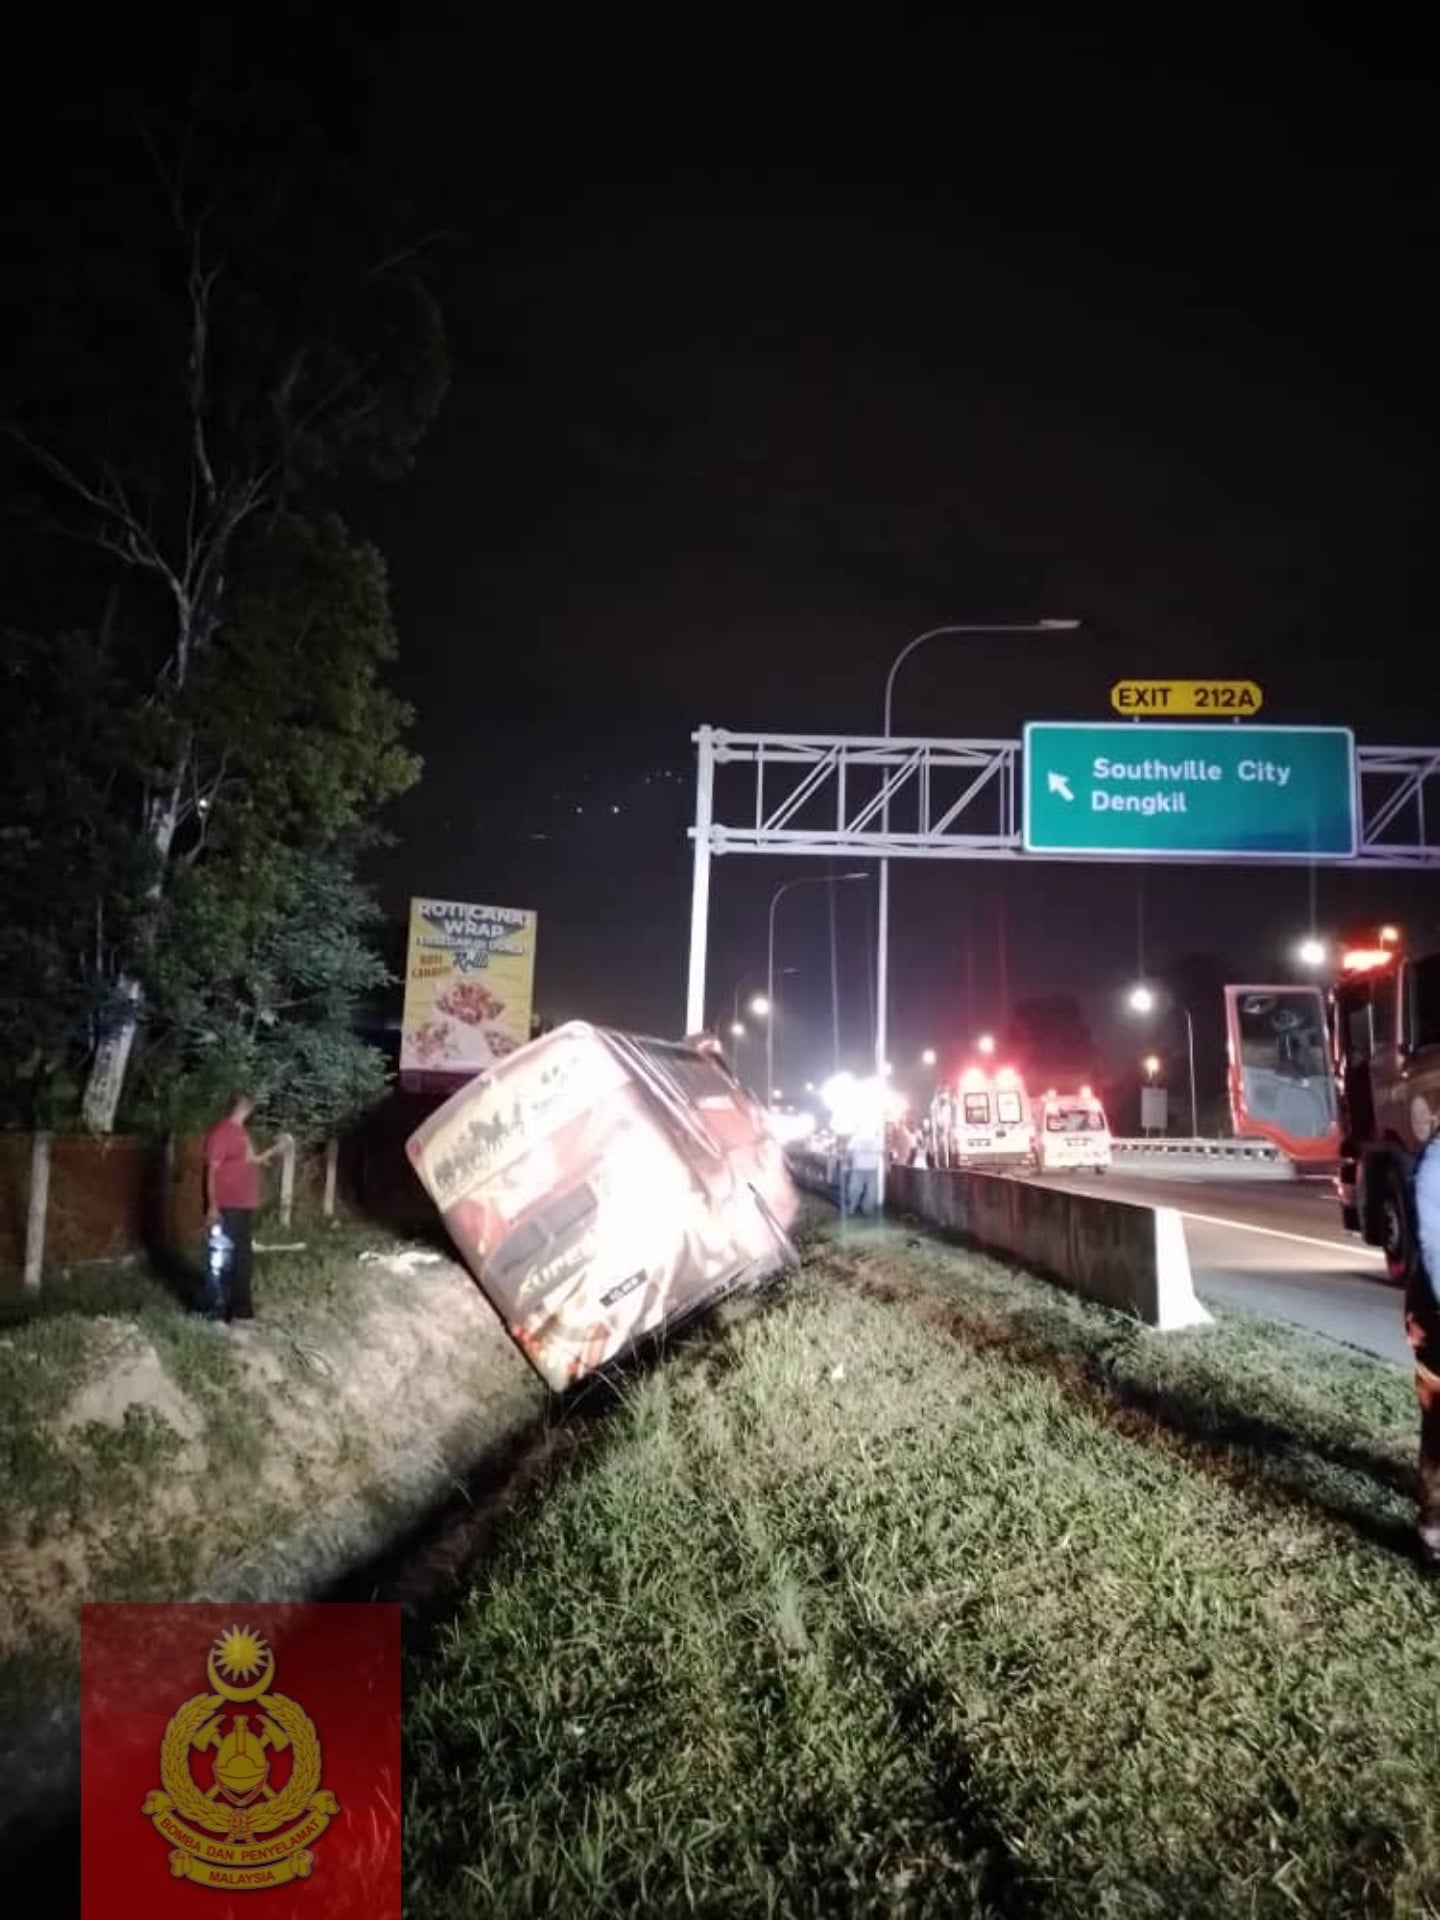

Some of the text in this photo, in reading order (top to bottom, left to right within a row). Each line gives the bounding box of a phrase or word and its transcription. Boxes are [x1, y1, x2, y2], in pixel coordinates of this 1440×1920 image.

[1118, 688, 1255, 708] EXIT 212A
[1092, 757, 1291, 785] Southville City
[1091, 790, 1187, 815] Dengkil
[444, 919, 505, 937] WRAP
